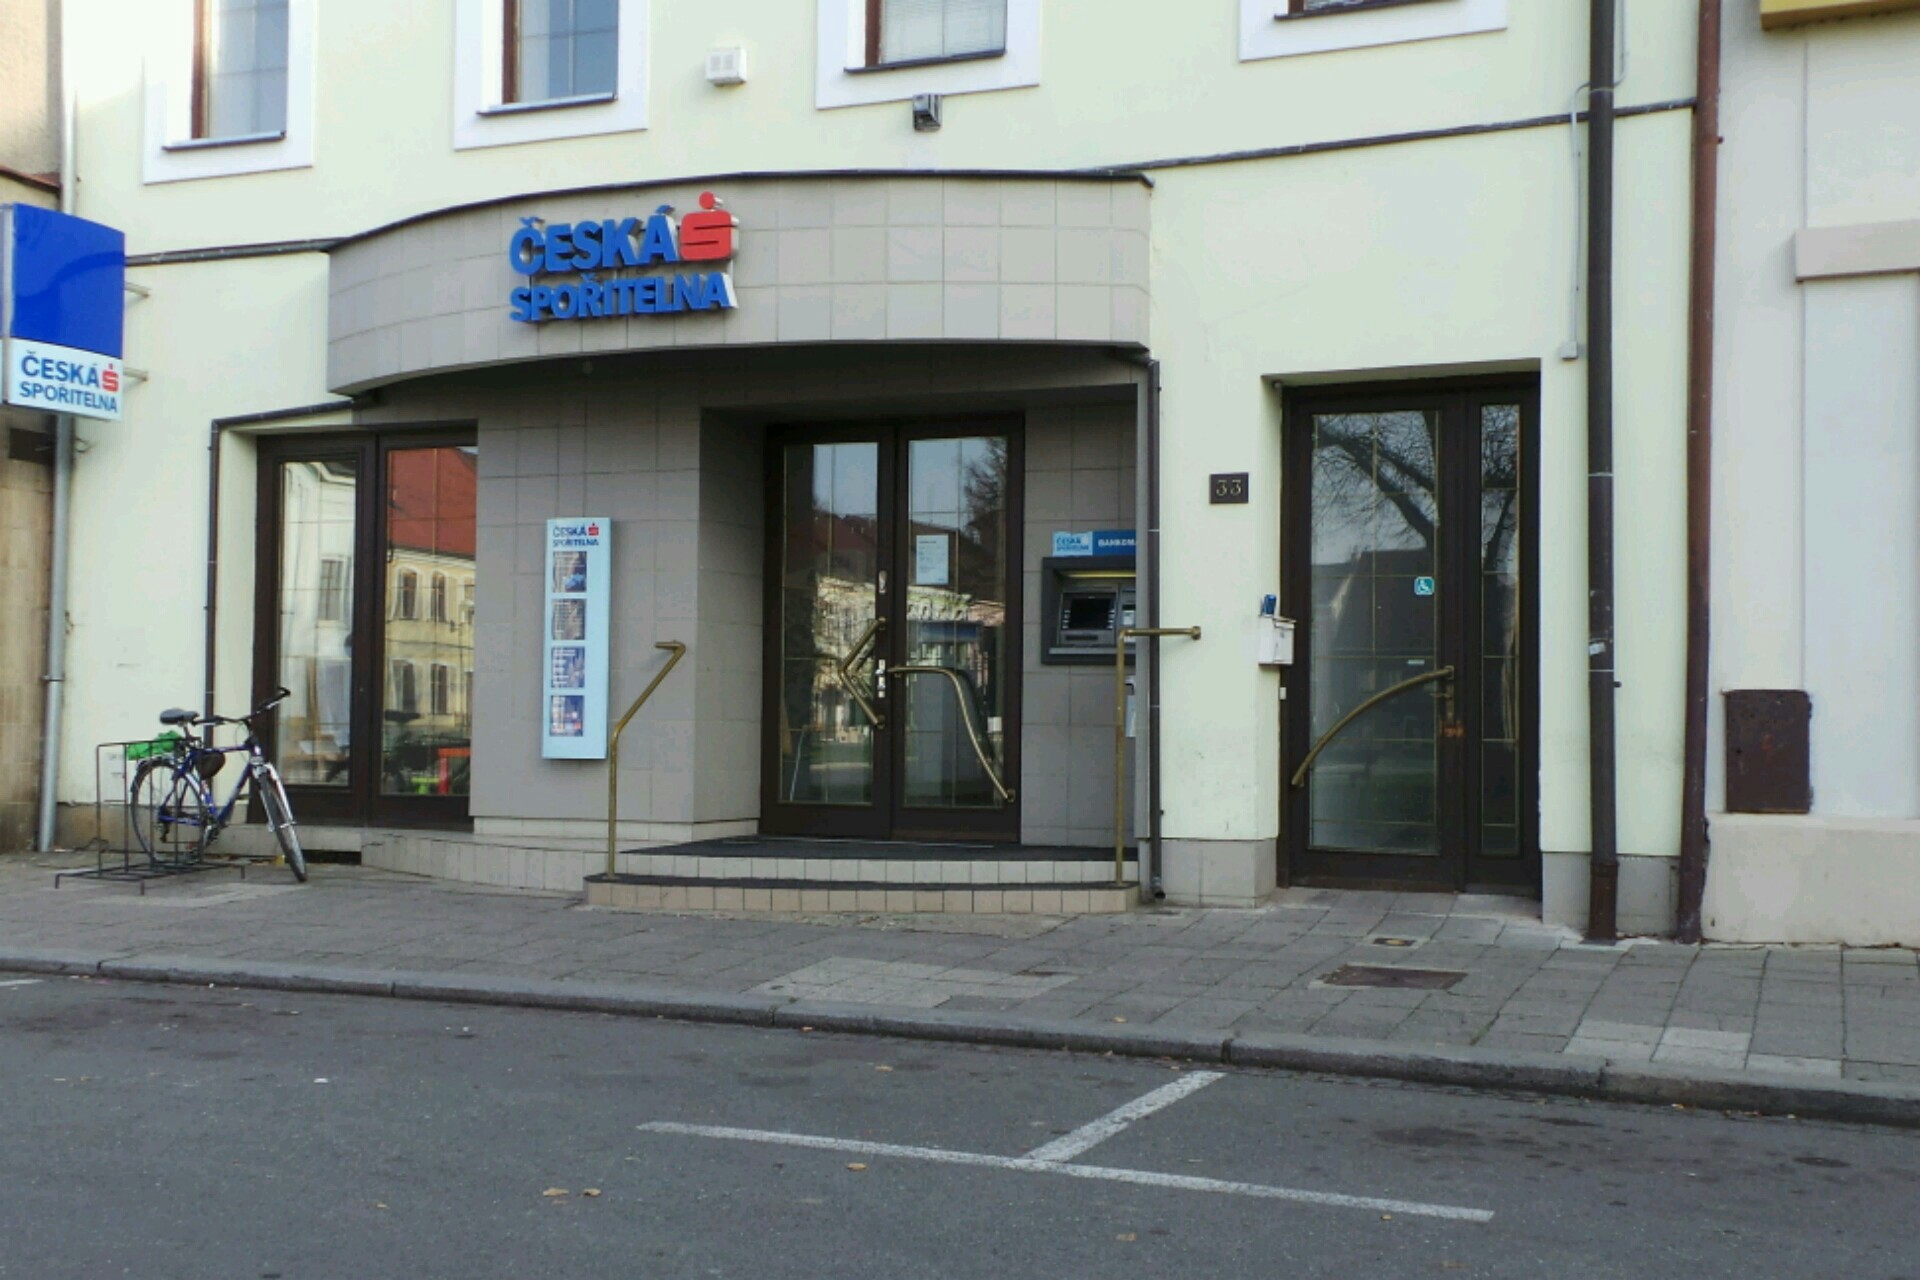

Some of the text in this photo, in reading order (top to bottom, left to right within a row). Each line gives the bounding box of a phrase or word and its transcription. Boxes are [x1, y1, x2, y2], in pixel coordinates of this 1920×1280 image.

[509, 205, 678, 276] ČESKÁ
[509, 271, 736, 322] SPOŘITELNA
[21, 350, 99, 388] ČESKÁ
[20, 381, 118, 412] SPOŘITELNA
[1216, 479, 1241, 496] 33
[1098, 538, 1136, 547] BANKOM
